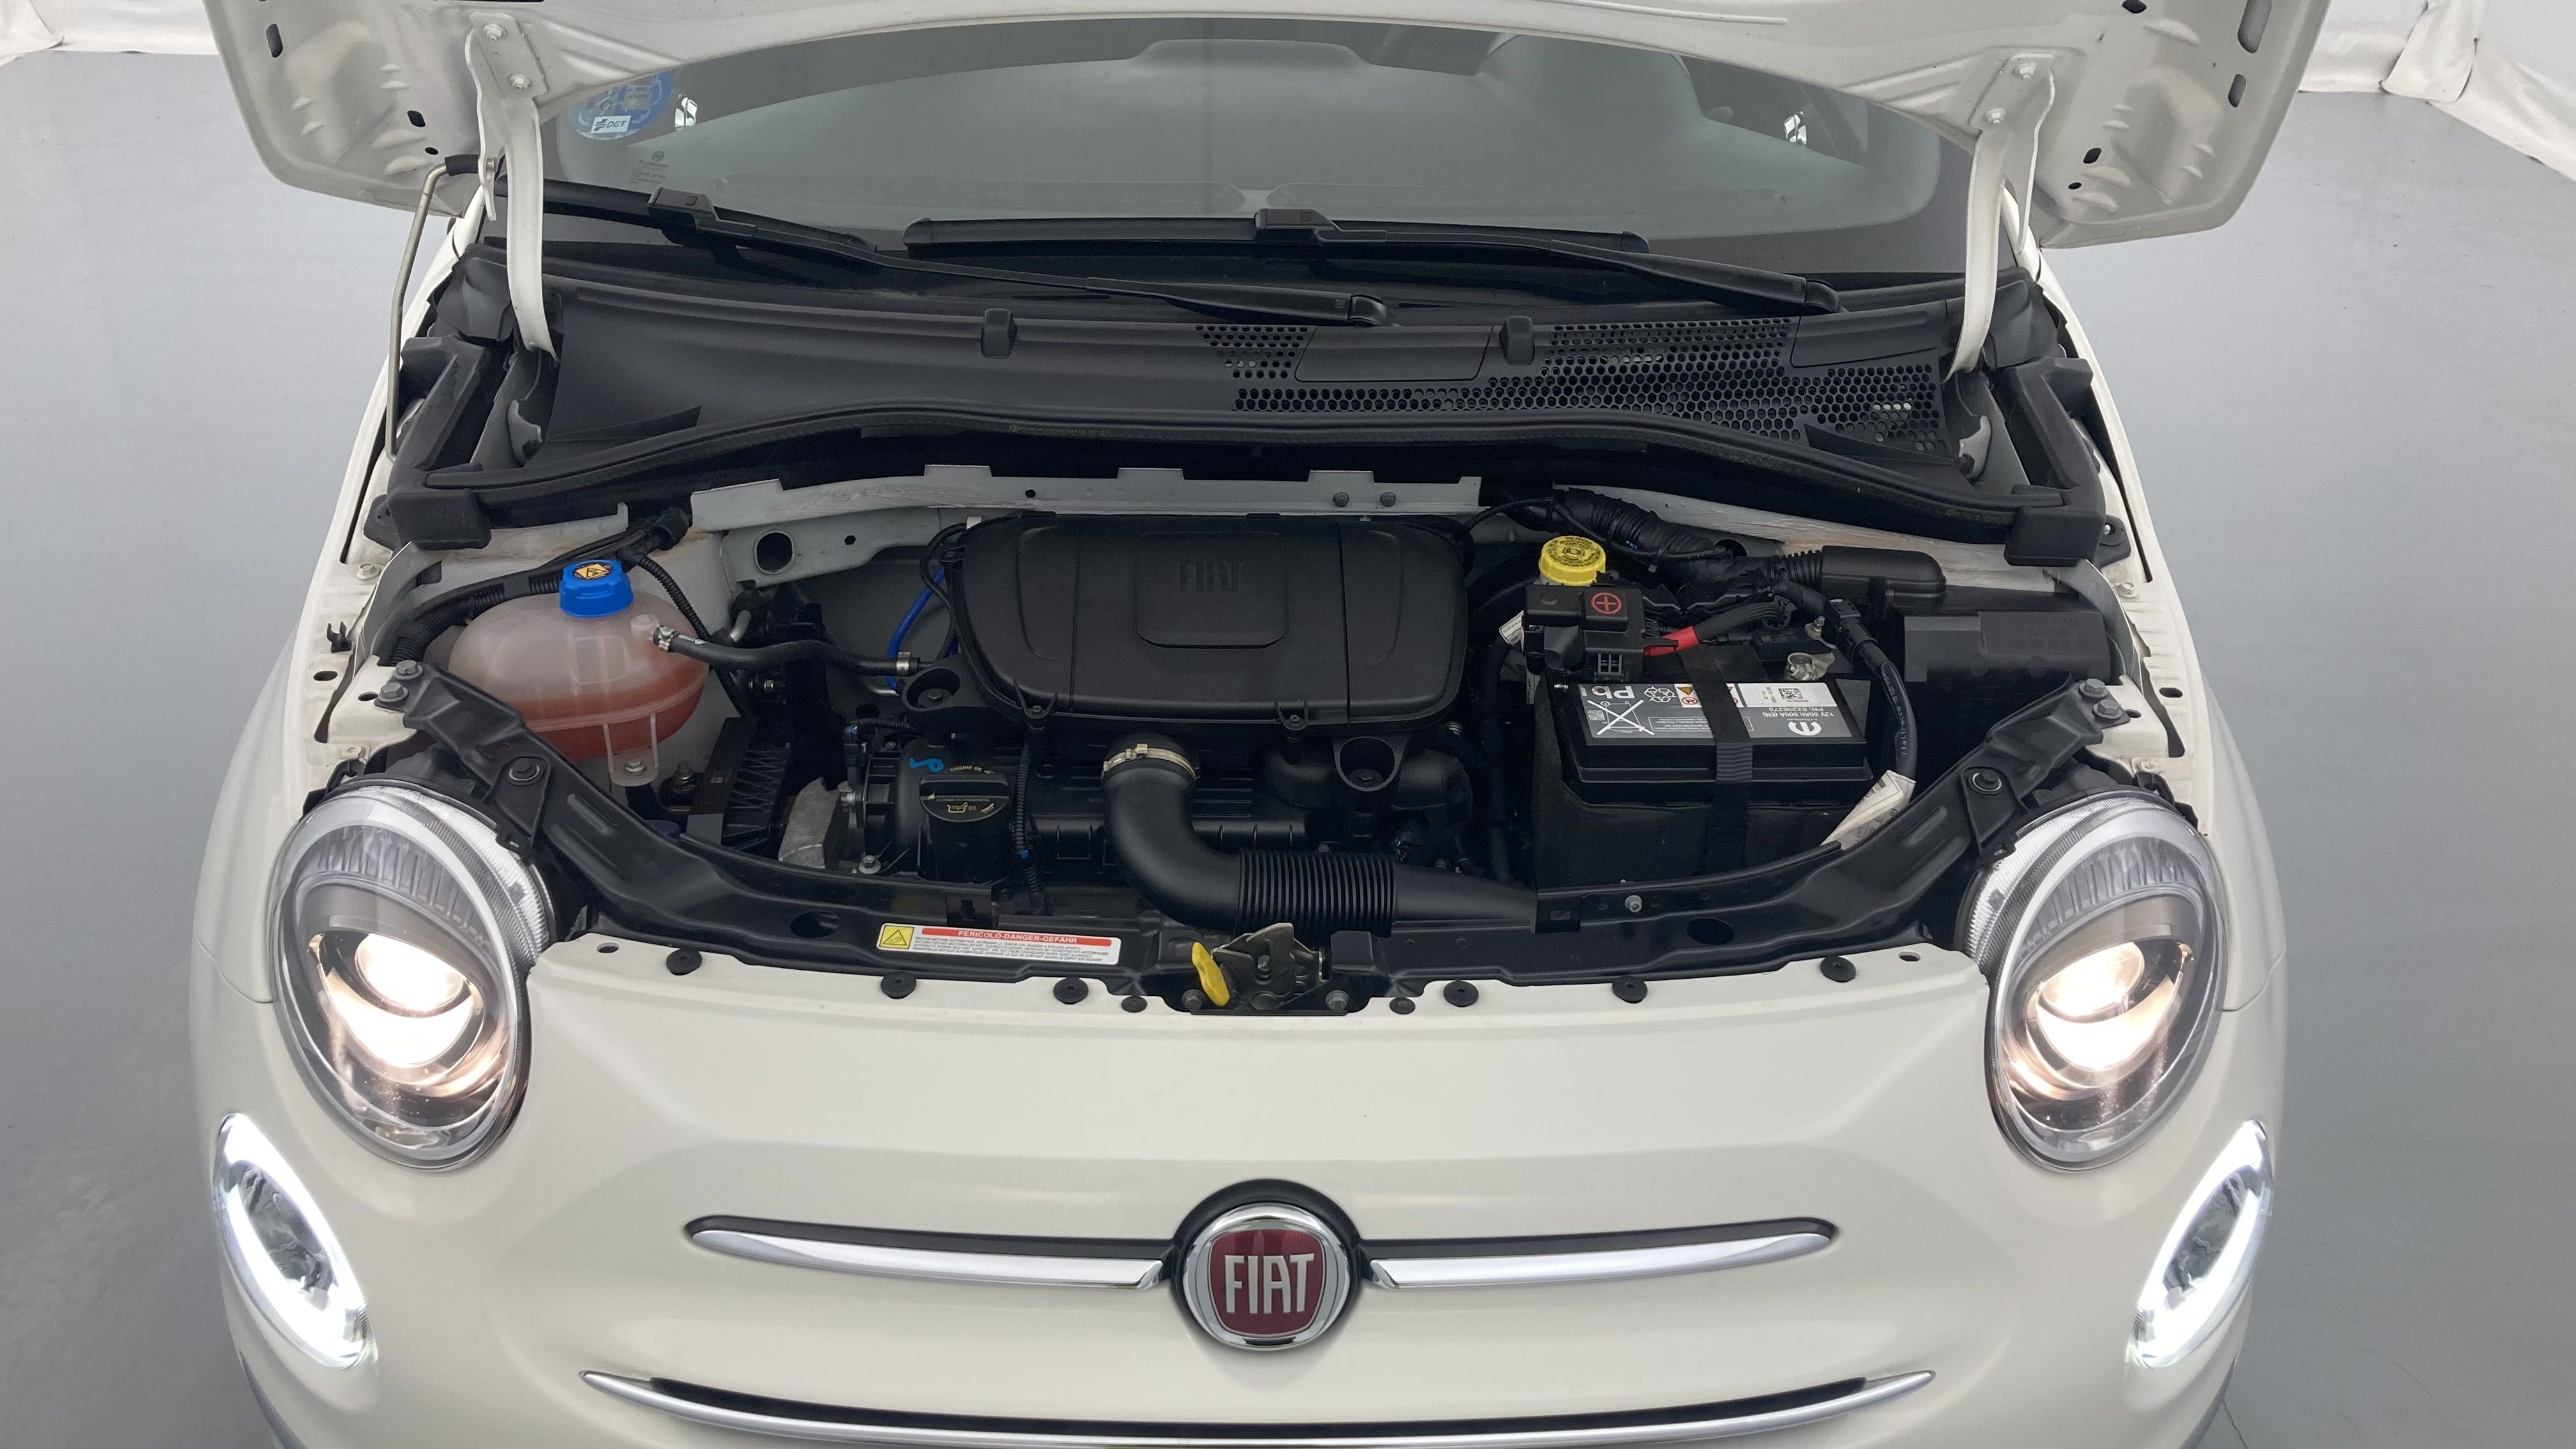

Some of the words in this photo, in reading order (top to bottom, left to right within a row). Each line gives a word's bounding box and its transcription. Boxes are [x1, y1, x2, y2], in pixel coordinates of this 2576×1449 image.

[607, 120, 627, 128] DGT
[1177, 559, 1245, 595] FIAT
[1591, 685, 1636, 700] Pb
[958, 930, 1078, 943] PERICOLO-DANGER-GEFAHR
[1225, 1253, 1315, 1315] FIAT
